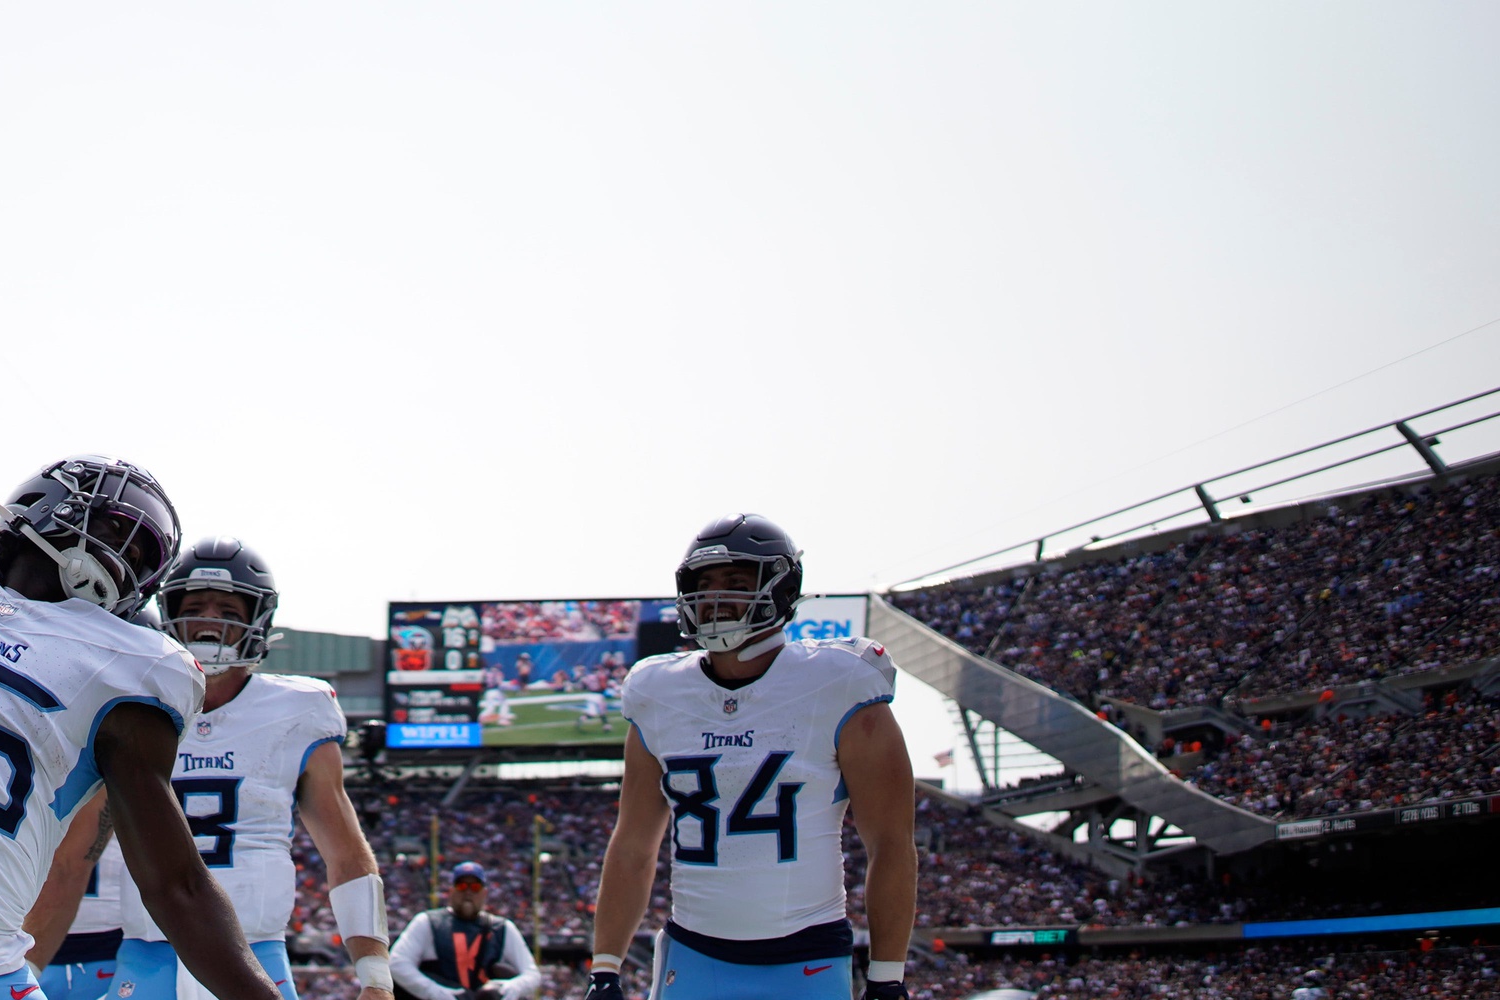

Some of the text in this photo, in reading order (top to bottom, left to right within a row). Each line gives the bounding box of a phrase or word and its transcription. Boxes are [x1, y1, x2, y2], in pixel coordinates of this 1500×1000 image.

[444, 628, 467, 648] 16
[702, 729, 754, 749] TITANS
[178, 751, 234, 772] TITANS
[662, 751, 805, 867] 84
[170, 776, 245, 868] 8
